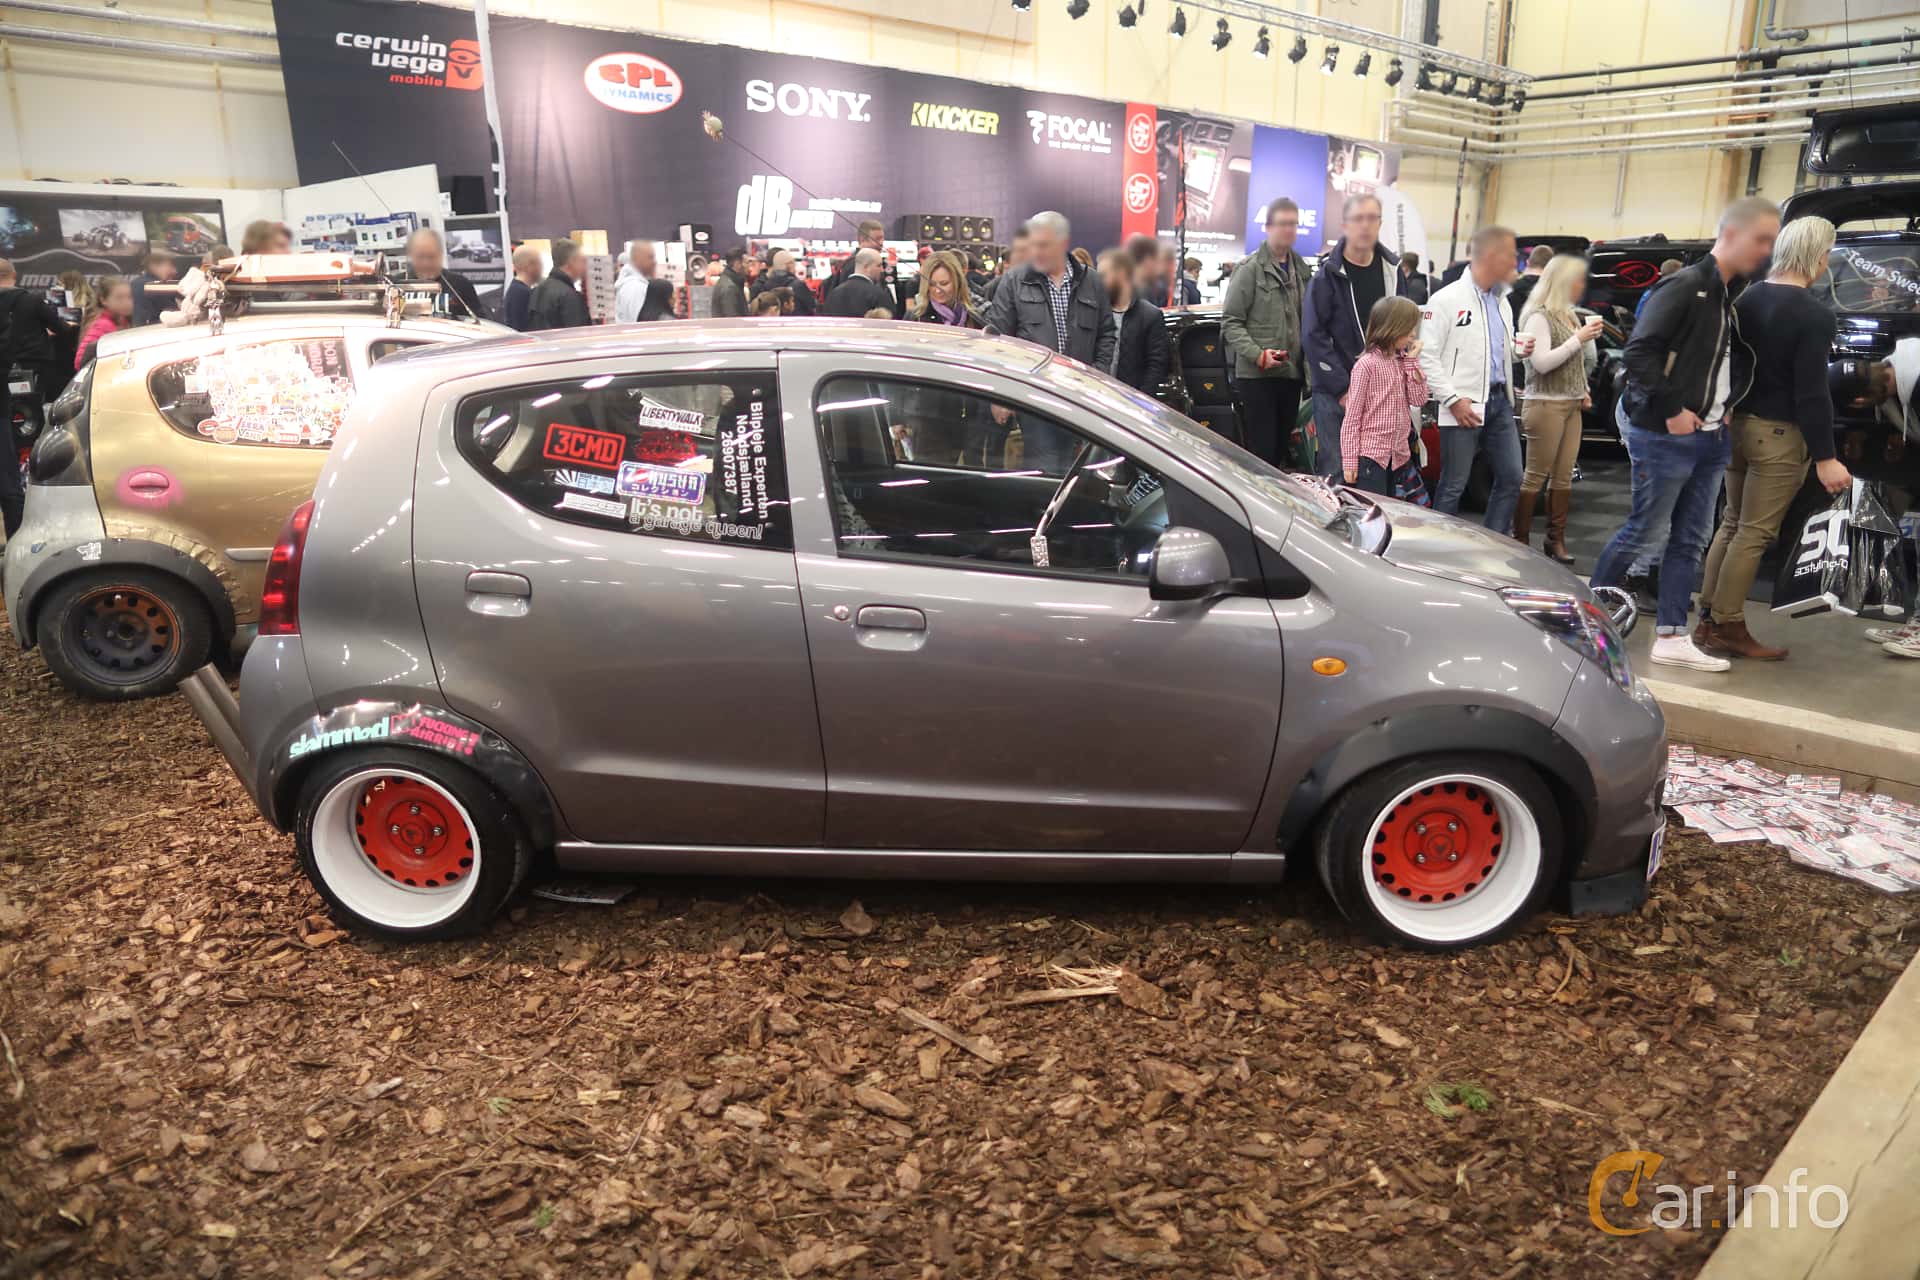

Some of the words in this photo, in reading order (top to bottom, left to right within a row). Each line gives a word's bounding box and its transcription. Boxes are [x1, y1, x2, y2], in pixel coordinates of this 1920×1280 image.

[336, 32, 448, 57] cerwin
[371, 52, 446, 74] vega
[598, 62, 673, 88] SPL
[389, 74, 444, 87] mobile
[602, 88, 673, 103] YNAMICS
[927, 106, 999, 135] KICKER
[1047, 115, 1112, 144] FOCAL
[735, 174, 793, 235] dB
[1847, 250, 1886, 280] Team
[751, 401, 766, 454] Bilpleje
[553, 430, 619, 463] 3CMD
[643, 513, 703, 535] garage
[666, 504, 703, 522] not
